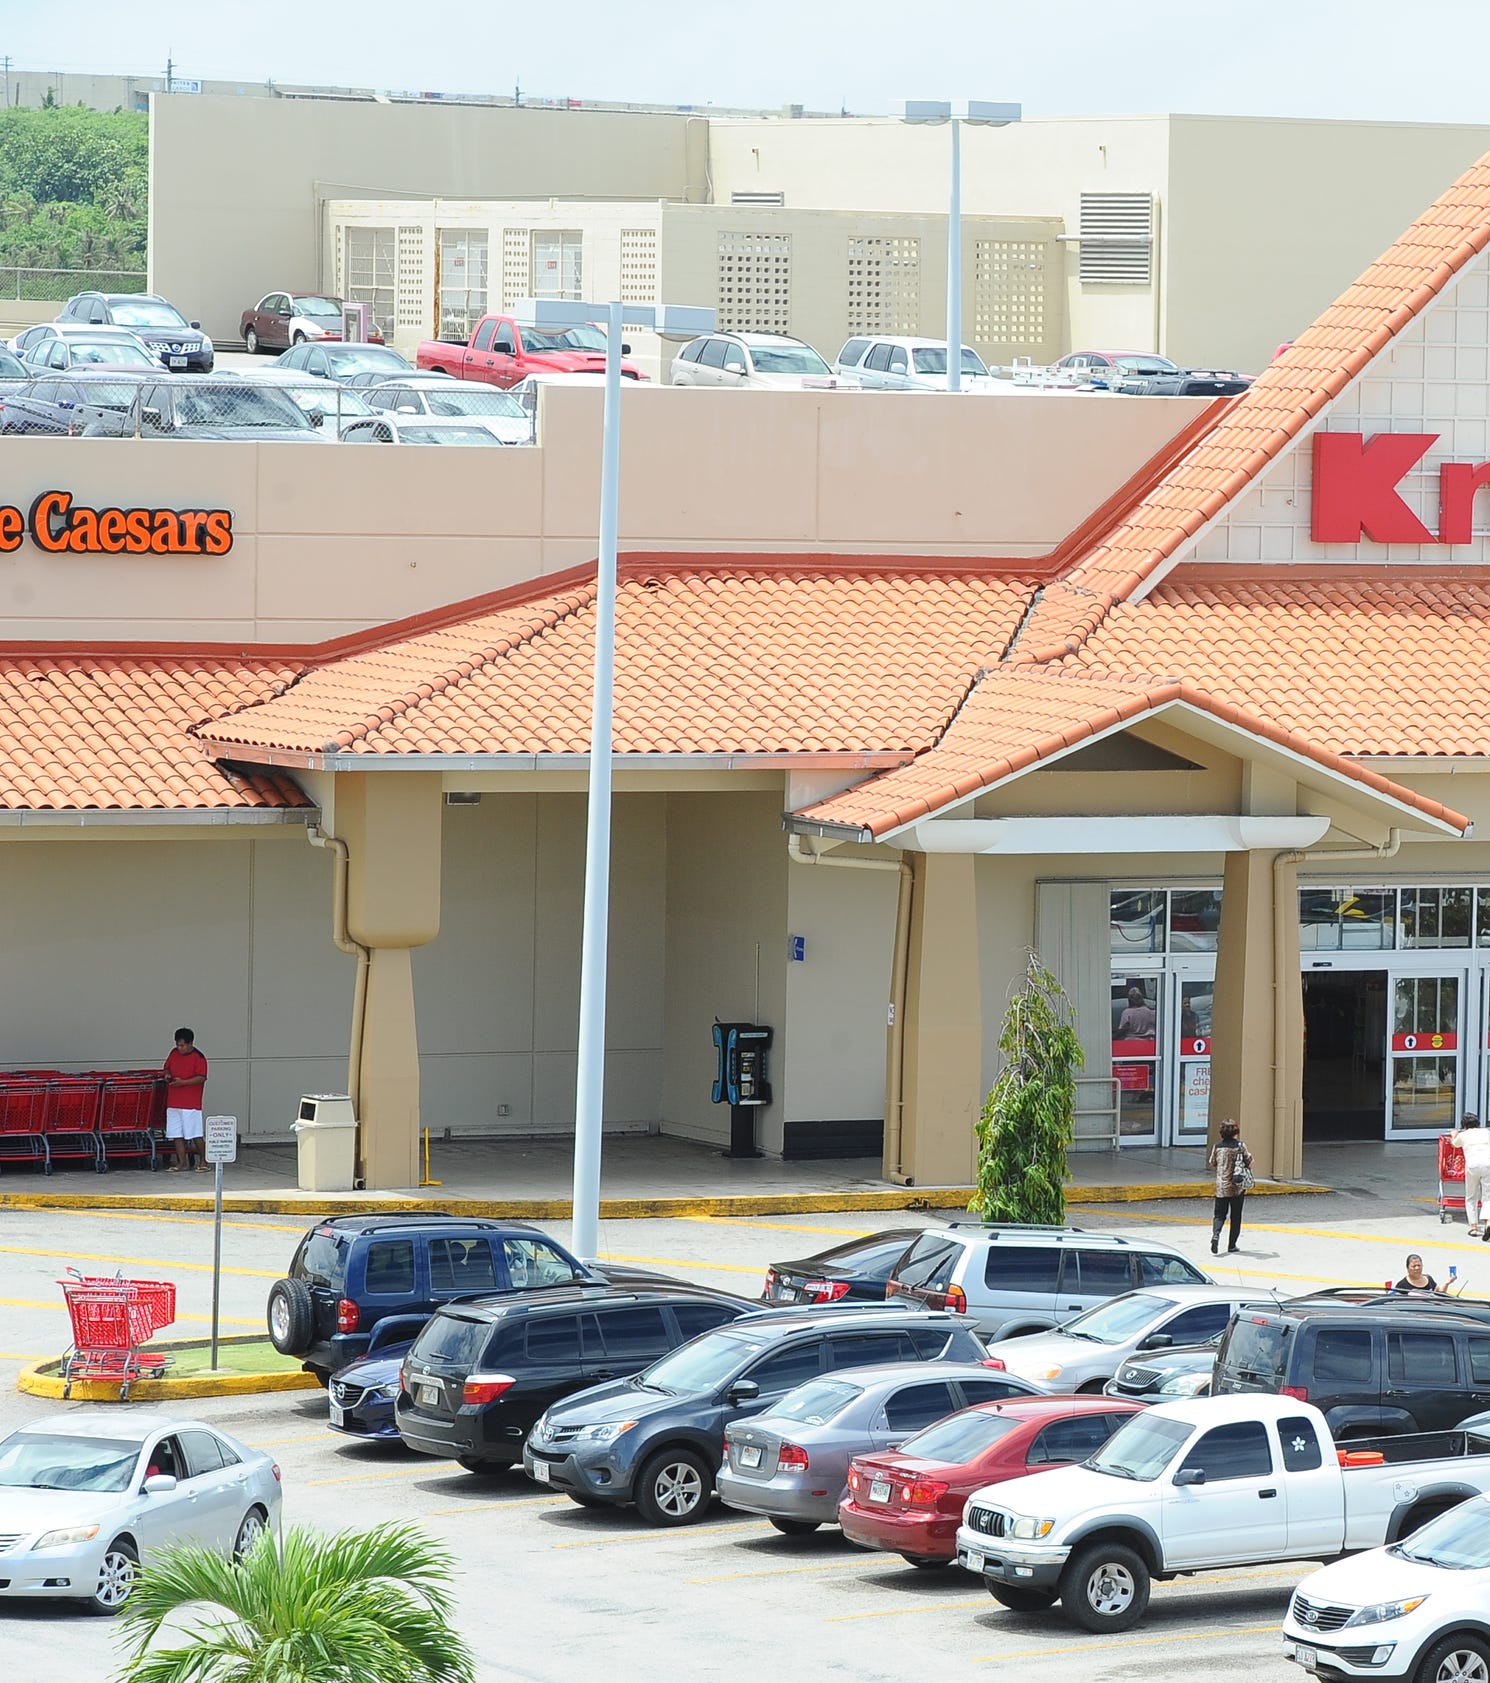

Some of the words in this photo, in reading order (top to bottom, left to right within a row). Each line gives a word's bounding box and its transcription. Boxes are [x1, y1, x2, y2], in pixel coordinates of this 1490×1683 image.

[29, 490, 234, 555] Caesars
[1196, 1067, 1211, 1076] FRE
[1193, 1077, 1211, 1086] che
